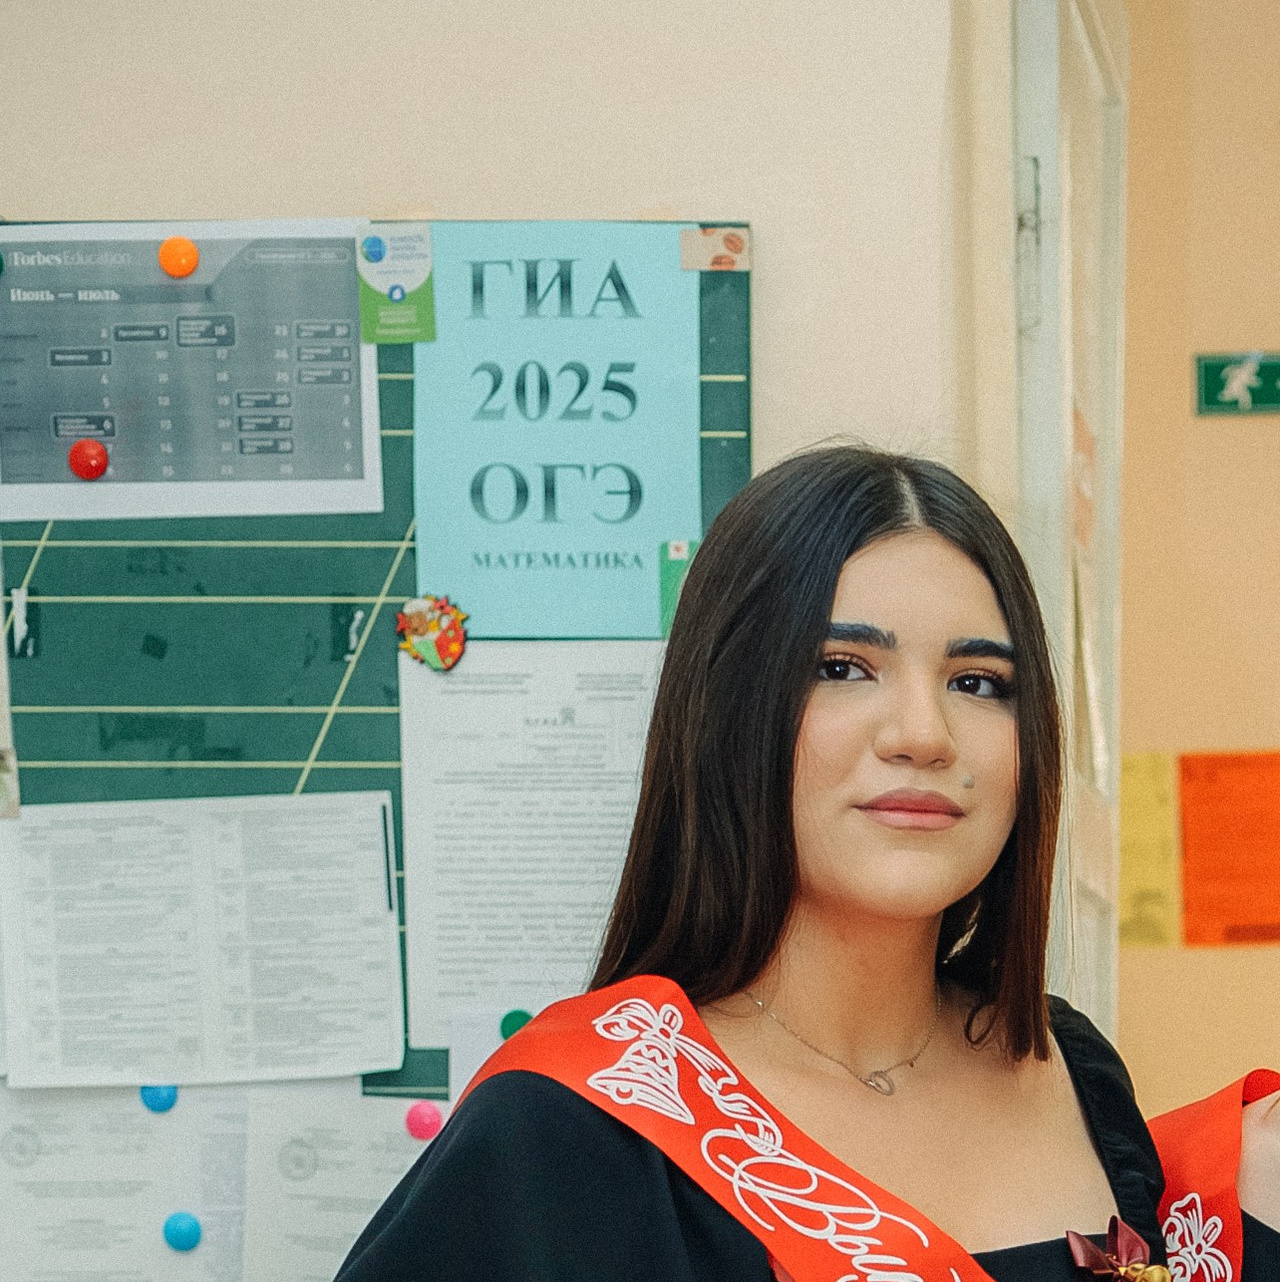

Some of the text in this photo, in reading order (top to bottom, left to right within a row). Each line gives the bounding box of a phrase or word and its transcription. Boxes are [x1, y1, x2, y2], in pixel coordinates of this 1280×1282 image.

[464, 258, 644, 319] ГИА
[471, 360, 639, 422] 2025
[469, 463, 644, 525] ОГЭ
[473, 550, 645, 570] МАТЕМАТИКА
